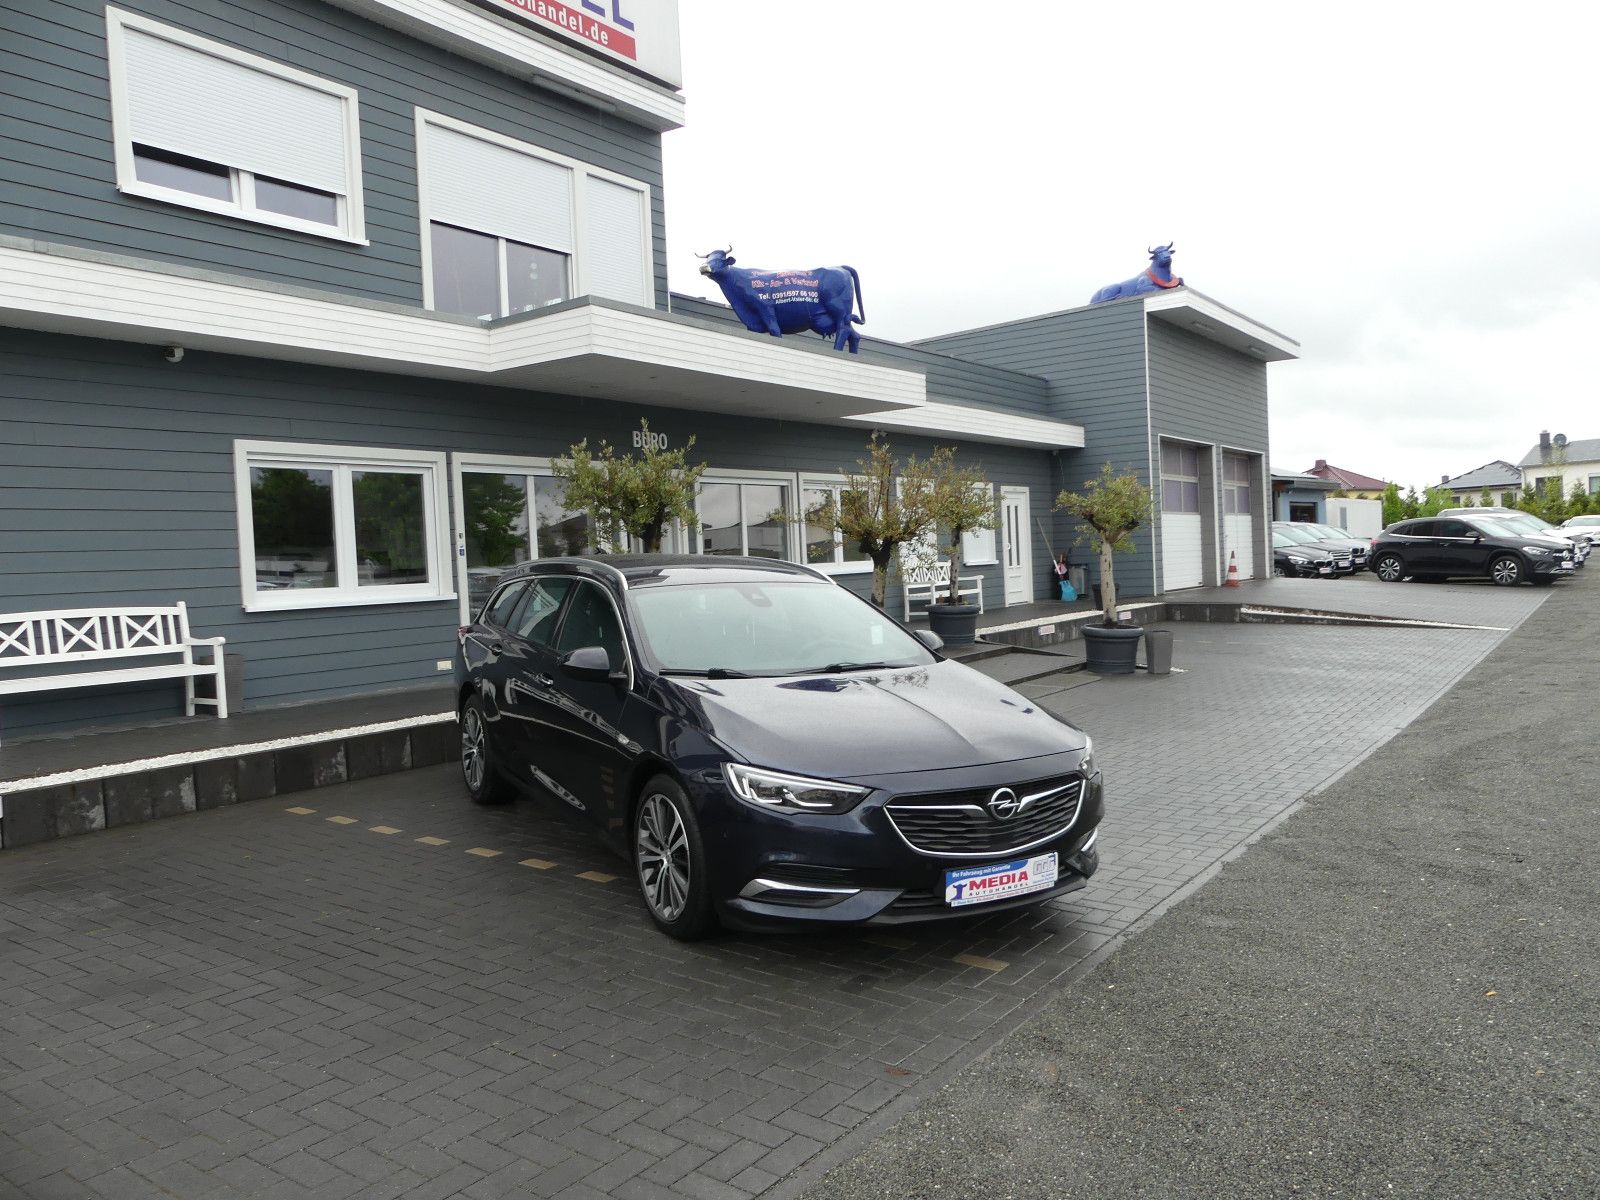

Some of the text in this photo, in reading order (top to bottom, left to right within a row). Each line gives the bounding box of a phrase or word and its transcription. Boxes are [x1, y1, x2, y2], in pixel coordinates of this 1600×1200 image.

[758, 292, 770, 300] Tel.
[983, 866, 992, 874] mit
[991, 864, 1011, 873] Garantie
[968, 870, 1028, 891] MEDIA
[968, 882, 1029, 896] AUTOHANDEL
